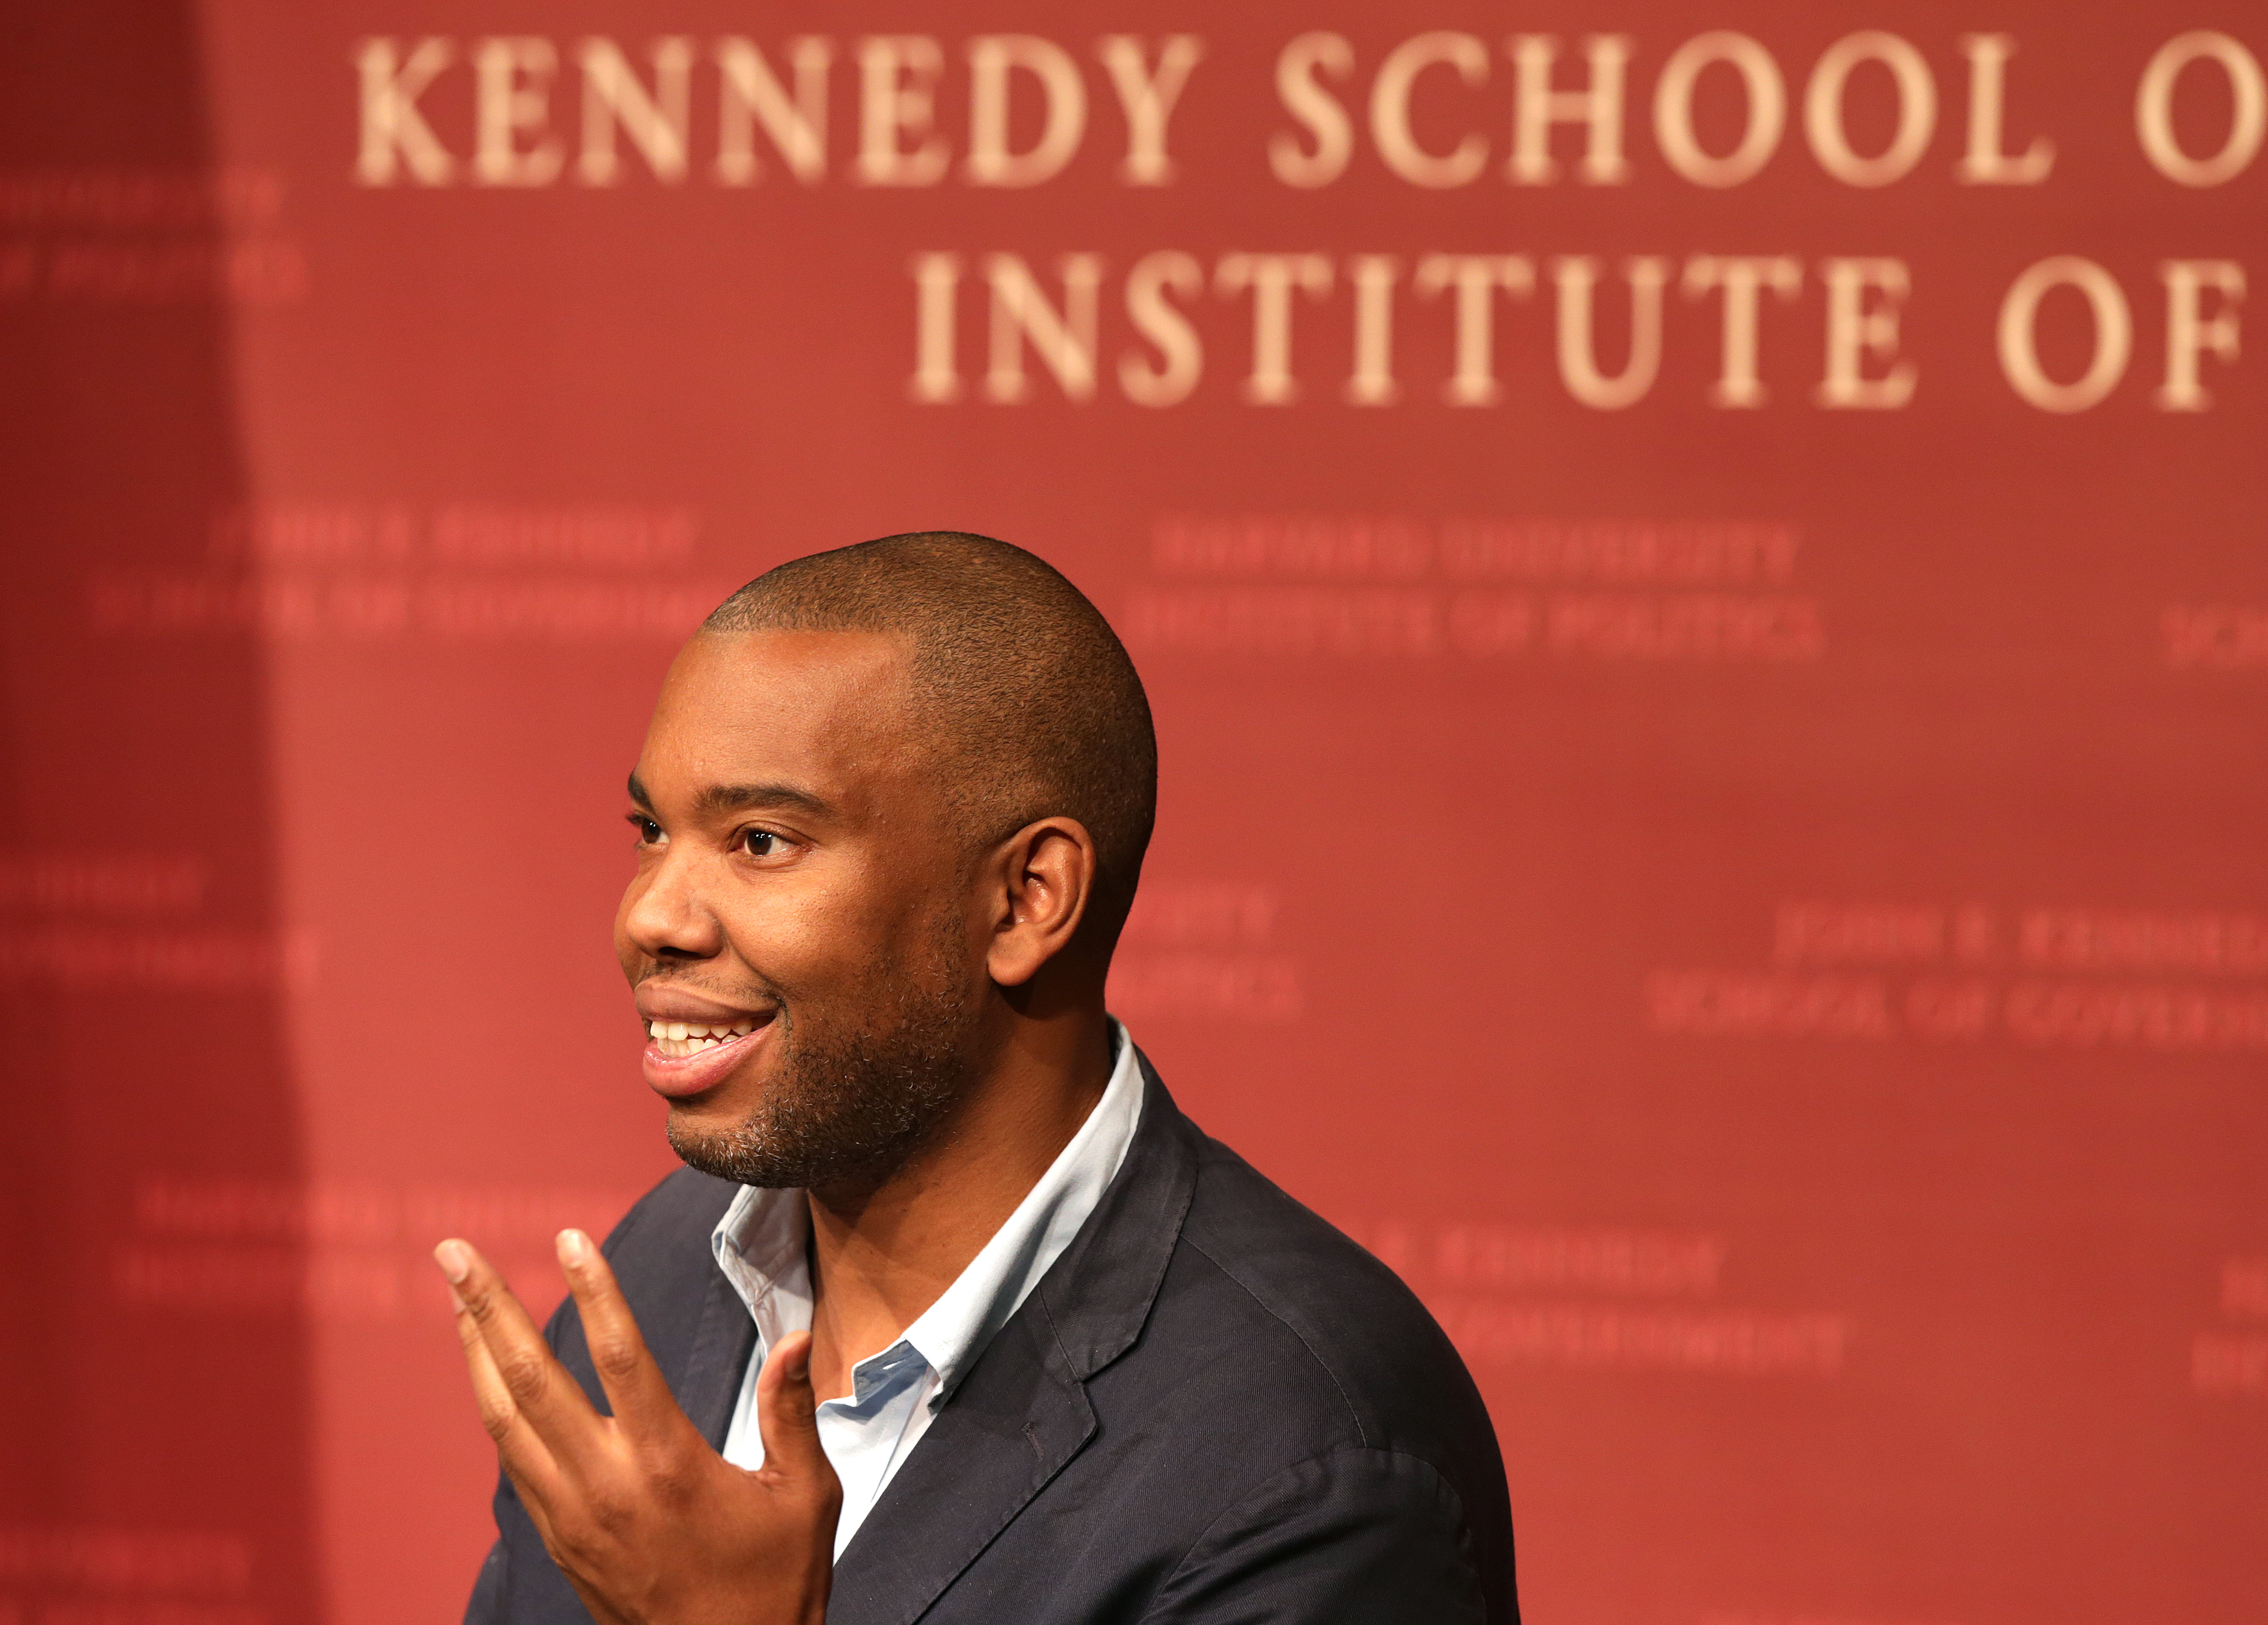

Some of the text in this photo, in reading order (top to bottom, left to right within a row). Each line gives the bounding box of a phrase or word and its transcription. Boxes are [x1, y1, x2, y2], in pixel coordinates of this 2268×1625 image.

[350, 34, 1205, 188] KENNEDY
[1267, 30, 2056, 189] SCHOOL
[907, 250, 2247, 415] INSTITUTE OF
